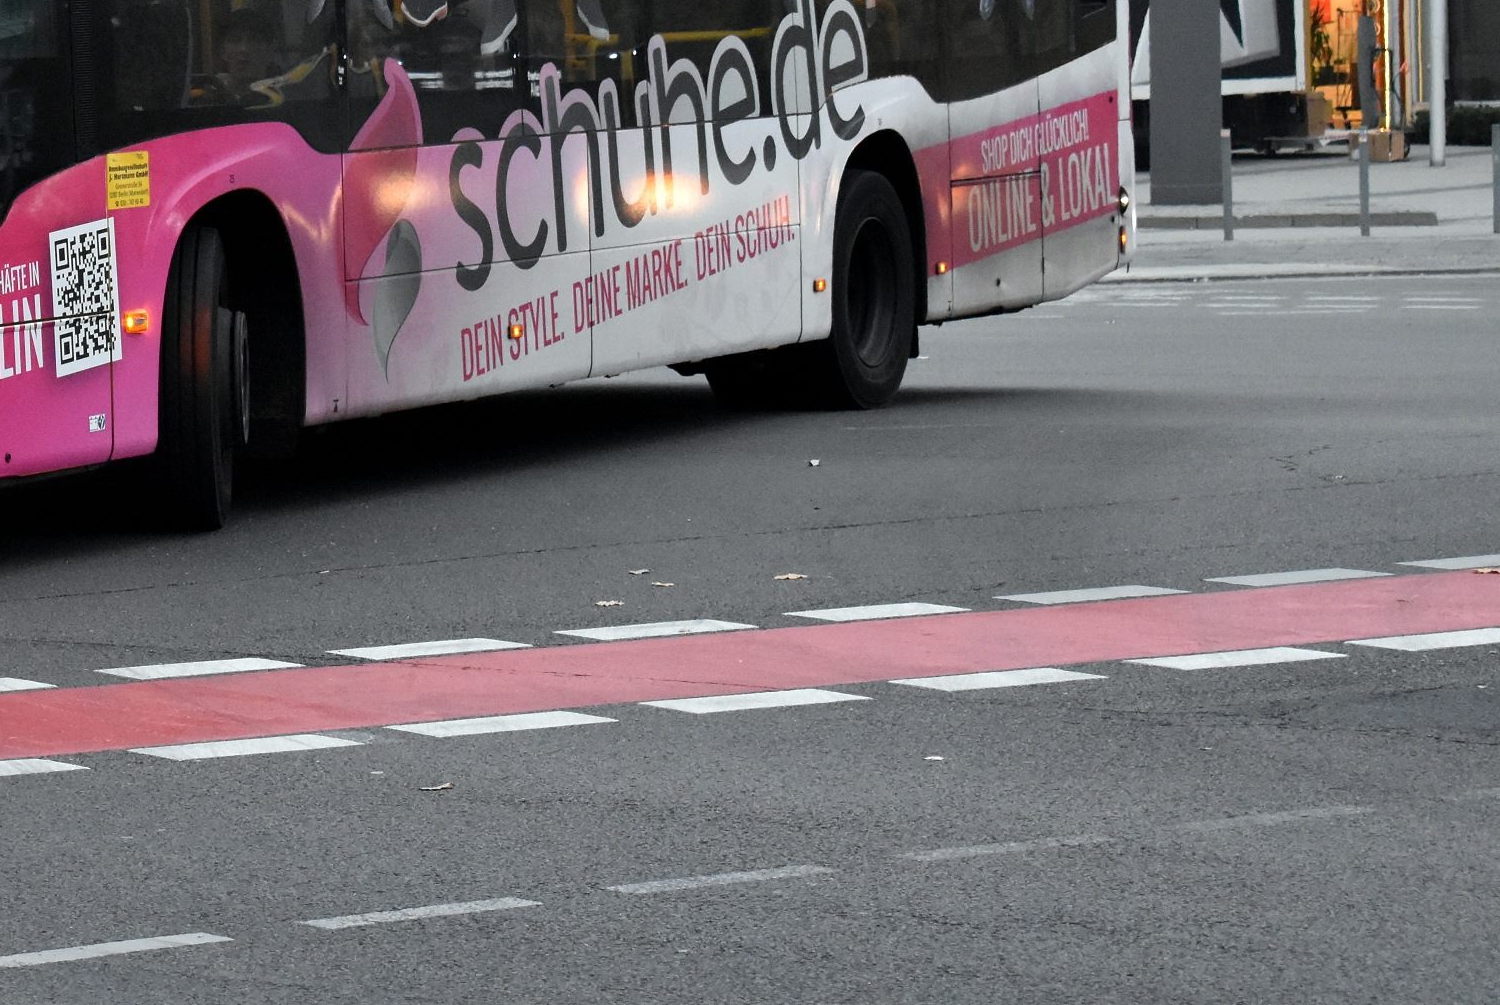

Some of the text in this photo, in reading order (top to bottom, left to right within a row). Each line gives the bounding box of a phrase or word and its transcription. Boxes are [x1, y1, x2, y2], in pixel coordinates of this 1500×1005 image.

[980, 108, 1090, 174] SHOP DICH GLÜCKLICH!
[968, 142, 1119, 253] ONLINE & LOKAL
[28, 260, 41, 287] IN
[460, 195, 796, 382] DEIN STYLE. DEINE MARKE. DEIN SCHUH.
